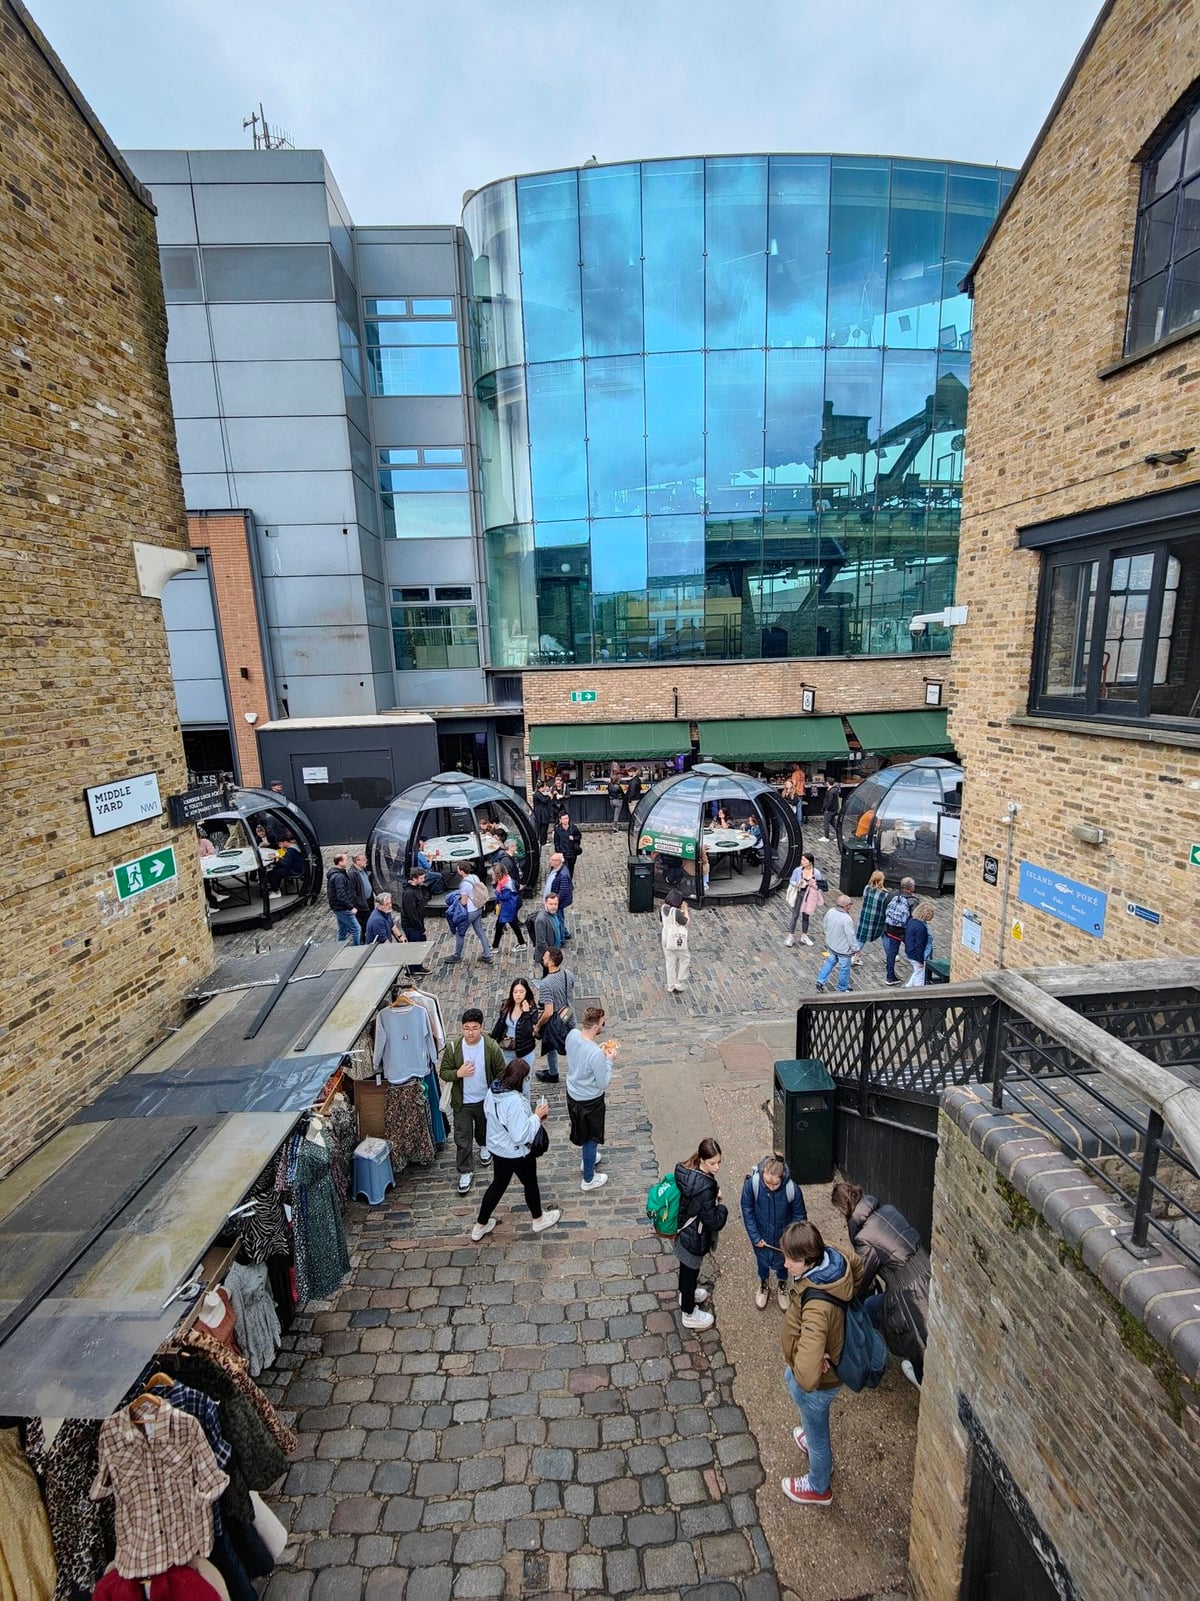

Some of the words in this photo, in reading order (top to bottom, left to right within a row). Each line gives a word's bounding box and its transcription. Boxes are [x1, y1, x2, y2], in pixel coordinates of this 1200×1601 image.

[94, 786, 132, 804] MIDDLE
[96, 800, 124, 815] YARD
[140, 801, 158, 814] NW1
[1026, 870, 1053, 886] ISLAND
